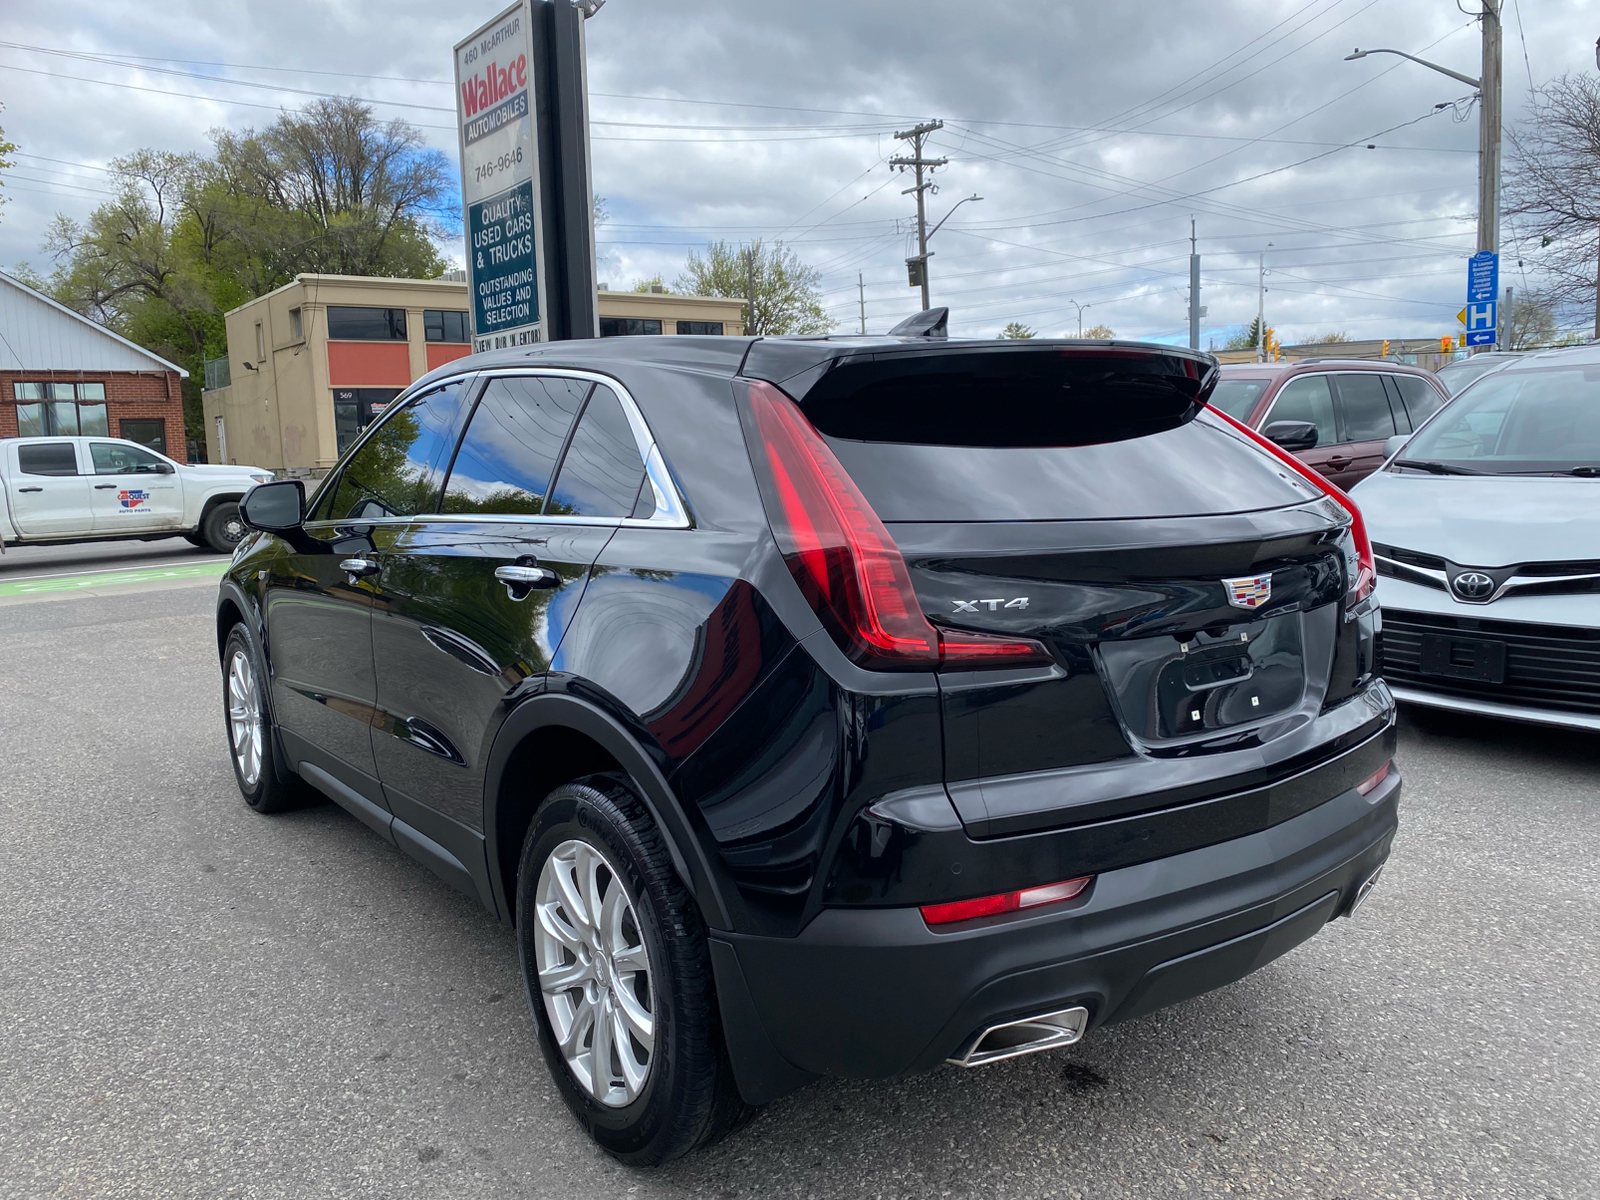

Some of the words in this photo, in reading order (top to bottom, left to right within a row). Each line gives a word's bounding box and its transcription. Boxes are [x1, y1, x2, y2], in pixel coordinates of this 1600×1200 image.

[464, 46, 478, 66] 460
[480, 17, 520, 56] McARTHUR
[461, 53, 527, 118] Wallace
[468, 95, 526, 141] AUTOMOBILES
[475, 146, 523, 183] 746-9646
[481, 194, 521, 225] QUALITY
[474, 225, 502, 248] USED
[505, 212, 532, 237] CARS
[476, 251, 485, 269] &
[489, 233, 532, 265] TRUCKS
[479, 267, 533, 296] OUTSTANDING
[482, 290, 512, 310] VALUES
[515, 285, 532, 302] AND
[486, 302, 530, 325] SELECTION
[1470, 303, 1493, 330] H
[951, 597, 1030, 613] XT4
